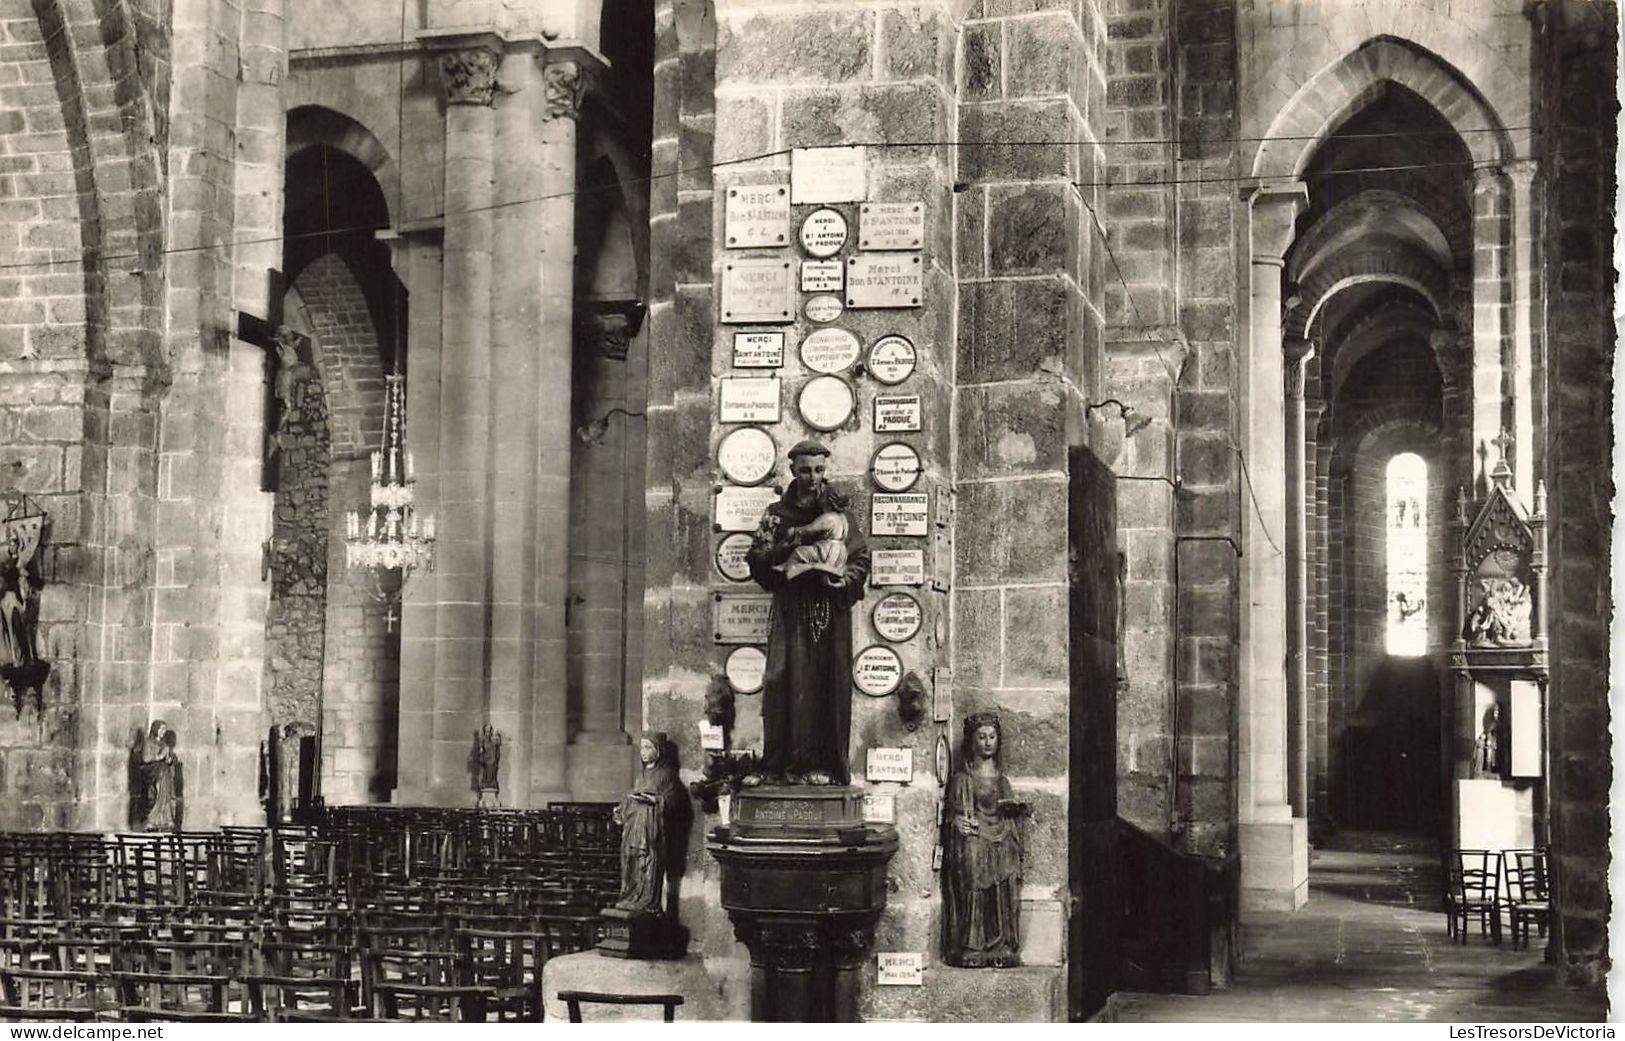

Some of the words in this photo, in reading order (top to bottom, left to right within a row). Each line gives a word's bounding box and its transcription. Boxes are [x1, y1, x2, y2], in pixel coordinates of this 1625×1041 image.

[741, 193, 776, 205] MERCI
[879, 216, 921, 226] ANTOINE
[817, 231, 844, 239] ANTOINE
[868, 264, 901, 274] Merci
[848, 277, 866, 287] Bon
[876, 275, 919, 286] ANTOINE
[882, 415, 912, 424] PADOUE
[874, 495, 927, 504] RECONNAISSANCE
[886, 512, 925, 521] ANTOINE
[730, 604, 768, 615] MERCI
[871, 664, 897, 672] ANTOINE
[875, 753, 904, 761] MERCI
[755, 808, 786, 820] ANTOINE
[885, 958, 915, 967] MERCI
